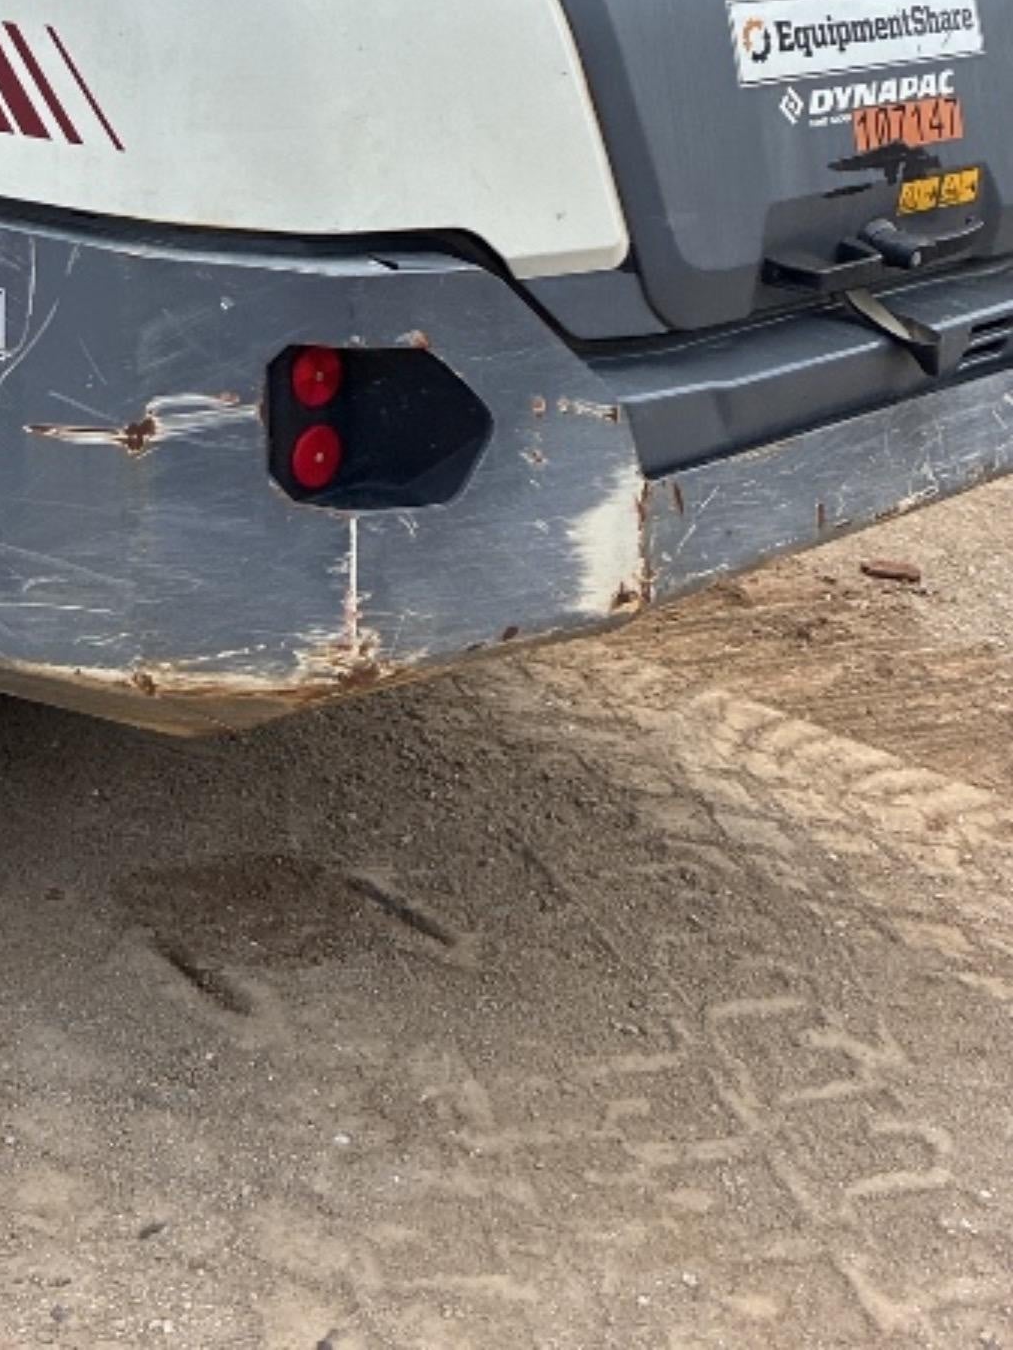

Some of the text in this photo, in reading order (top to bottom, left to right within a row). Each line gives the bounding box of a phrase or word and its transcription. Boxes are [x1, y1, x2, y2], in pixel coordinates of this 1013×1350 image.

[774, 5, 974, 57] EquipmentShare
[809, 69, 954, 115] DYNAPAC
[857, 98, 957, 150] 107147
